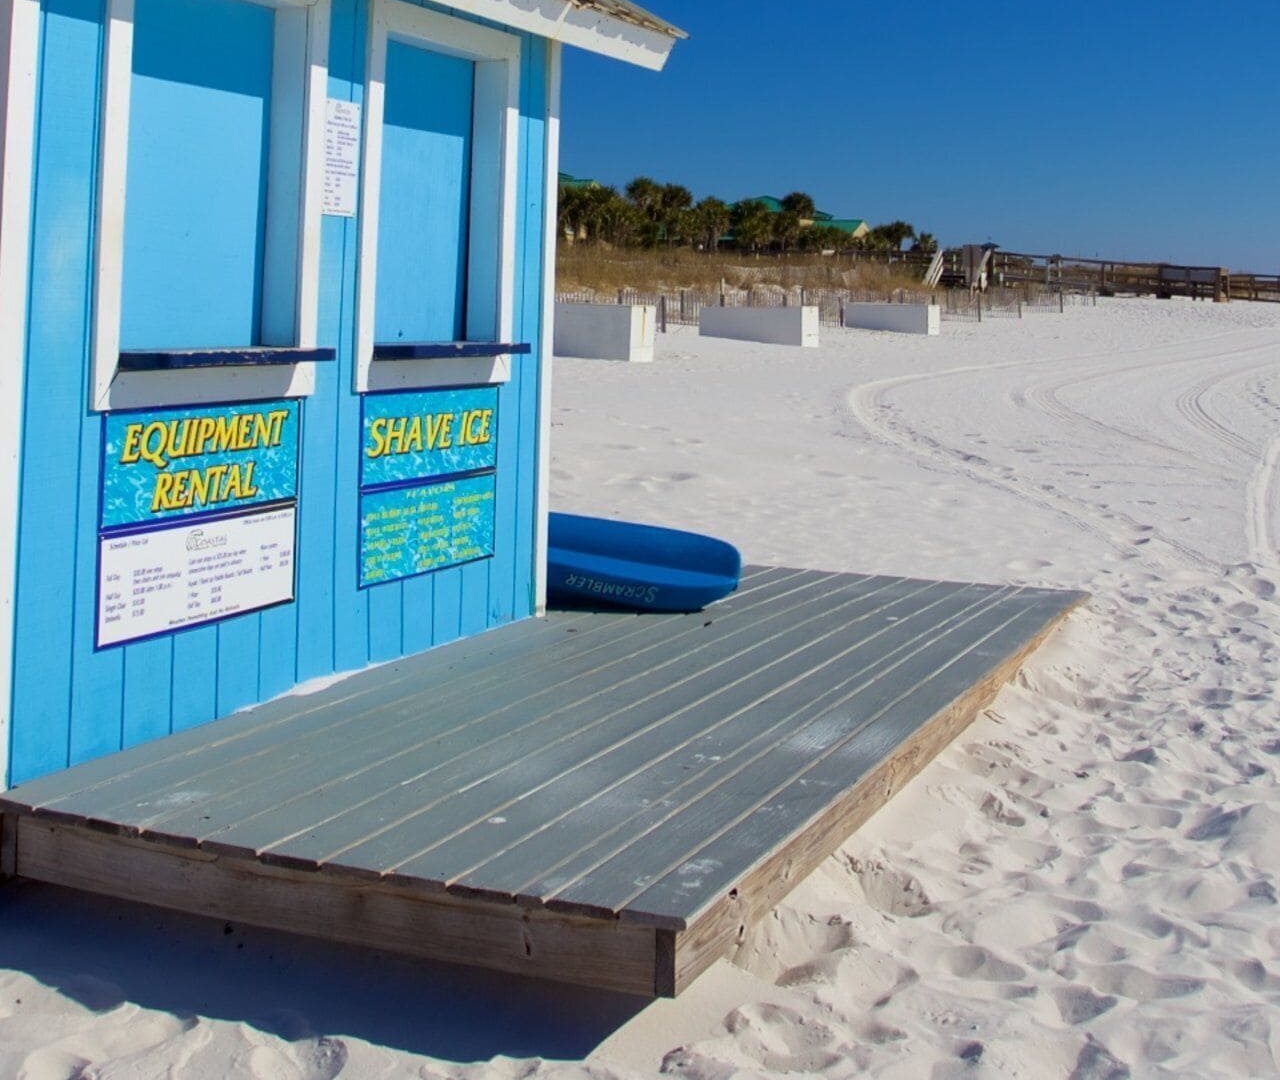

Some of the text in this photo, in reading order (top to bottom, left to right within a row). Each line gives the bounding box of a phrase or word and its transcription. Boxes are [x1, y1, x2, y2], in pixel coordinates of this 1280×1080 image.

[120, 410, 289, 468] EQUIPMENT
[367, 408, 493, 459] SHAVE ICE
[151, 461, 259, 514] RENTAL
[565, 573, 660, 604] SCRAMBLER
